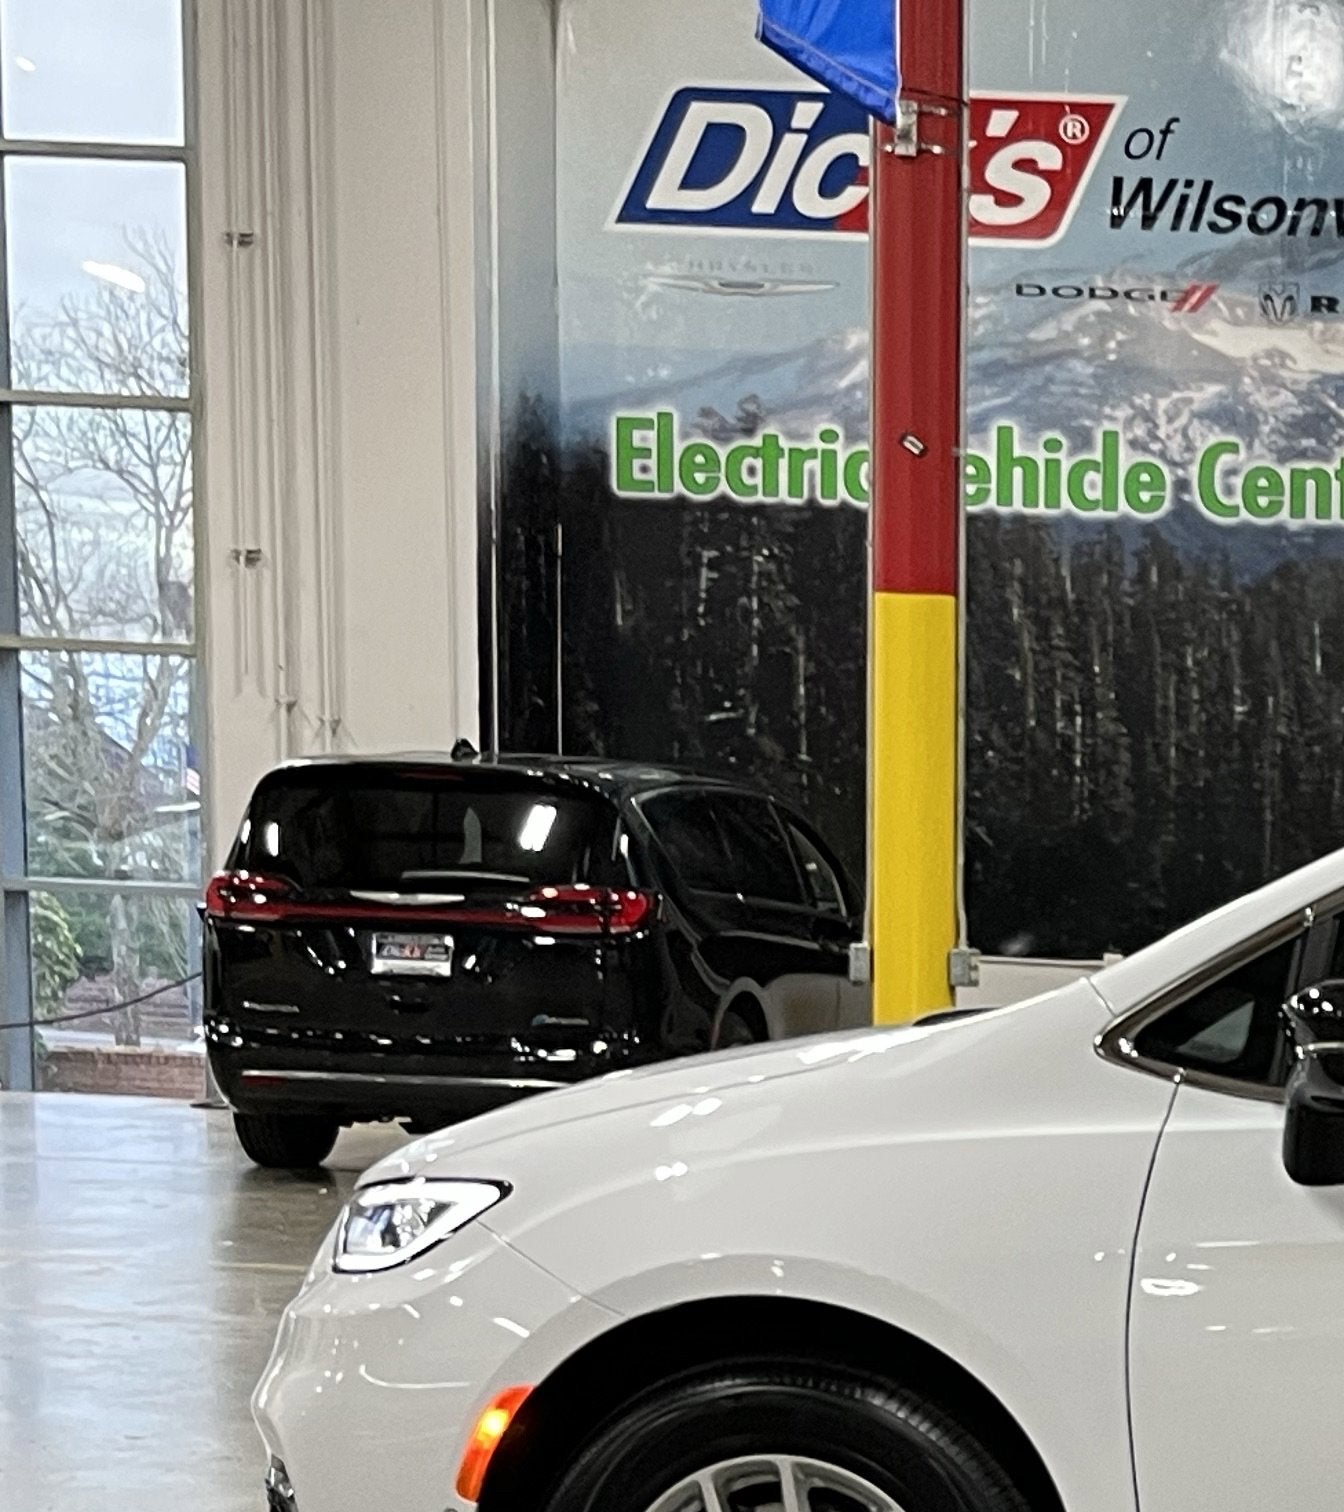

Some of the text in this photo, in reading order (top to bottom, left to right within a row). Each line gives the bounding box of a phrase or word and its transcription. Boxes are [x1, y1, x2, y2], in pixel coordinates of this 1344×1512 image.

[1123, 117, 1180, 161] of
[615, 411, 869, 503] Electric
[965, 425, 1167, 514] ehicle
